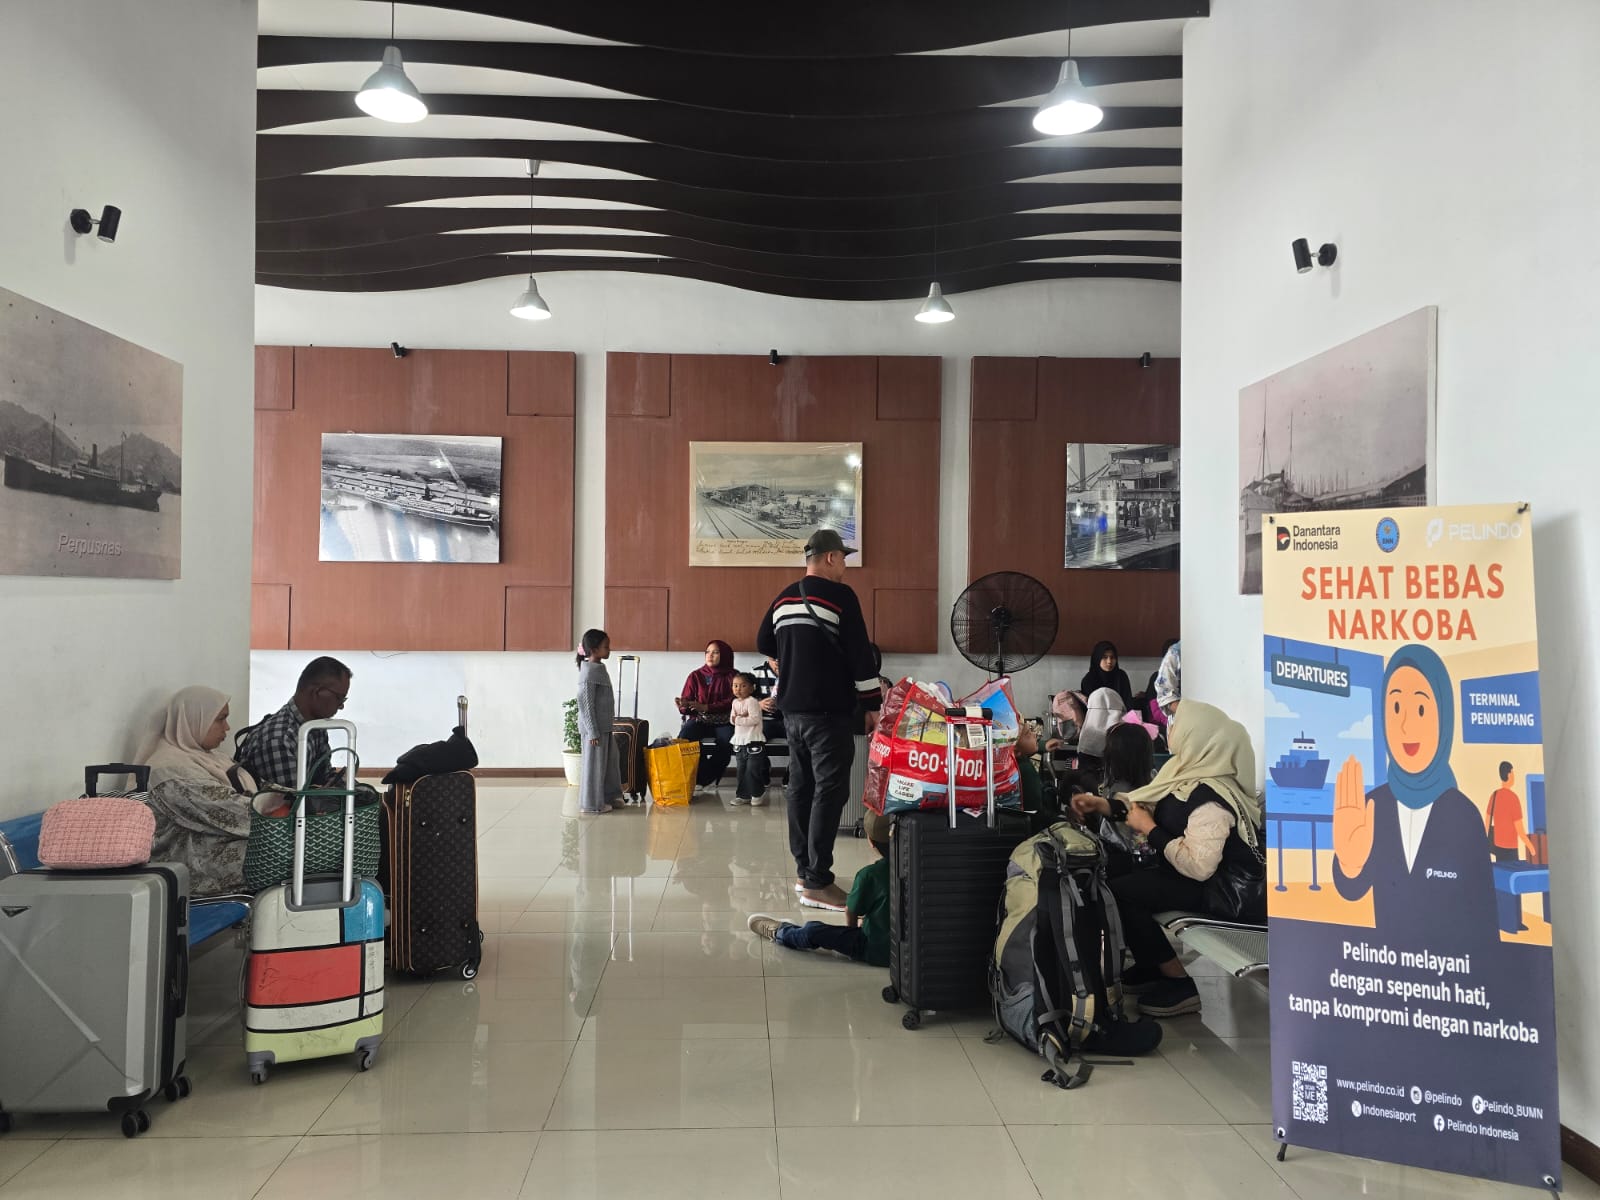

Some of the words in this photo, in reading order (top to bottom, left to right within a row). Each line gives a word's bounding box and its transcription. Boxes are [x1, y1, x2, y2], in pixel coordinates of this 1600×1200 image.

[1293, 525, 1341, 538] Danantara
[1448, 522, 1522, 541] PELINDO
[58, 534, 122, 558] Perpusnas
[1293, 538, 1339, 551] Indonesia
[1301, 565, 1394, 600] SEHAT
[1405, 563, 1505, 599] BEBAS
[1328, 608, 1477, 641] NARKOBA
[1276, 660, 1349, 688] DEPARTURES
[1469, 692, 1521, 707] TERMINAL
[1471, 712, 1535, 727] PENUMPANG
[1343, 941, 1397, 966] Pelindo
[1401, 949, 1470, 976] melayani
[1330, 968, 1383, 996] dengan
[1387, 979, 1451, 1002] sepenuh
[1455, 983, 1491, 1010] hati,
[1289, 993, 1330, 1019] tanpa
[1333, 998, 1409, 1027] kompromi
[1413, 1008, 1469, 1038] dengan
[1473, 1019, 1539, 1044] narkoba
[1336, 1078, 1405, 1098] www.pelindo.co.id
[1424, 1090, 1463, 1107] @pelindo
[1483, 1100, 1544, 1120] Pelindo_BUMN
[1362, 1104, 1417, 1123] Indonesiaport
[1447, 1119, 1478, 1135] Pelindo
[1479, 1125, 1520, 1142] Indonesia
